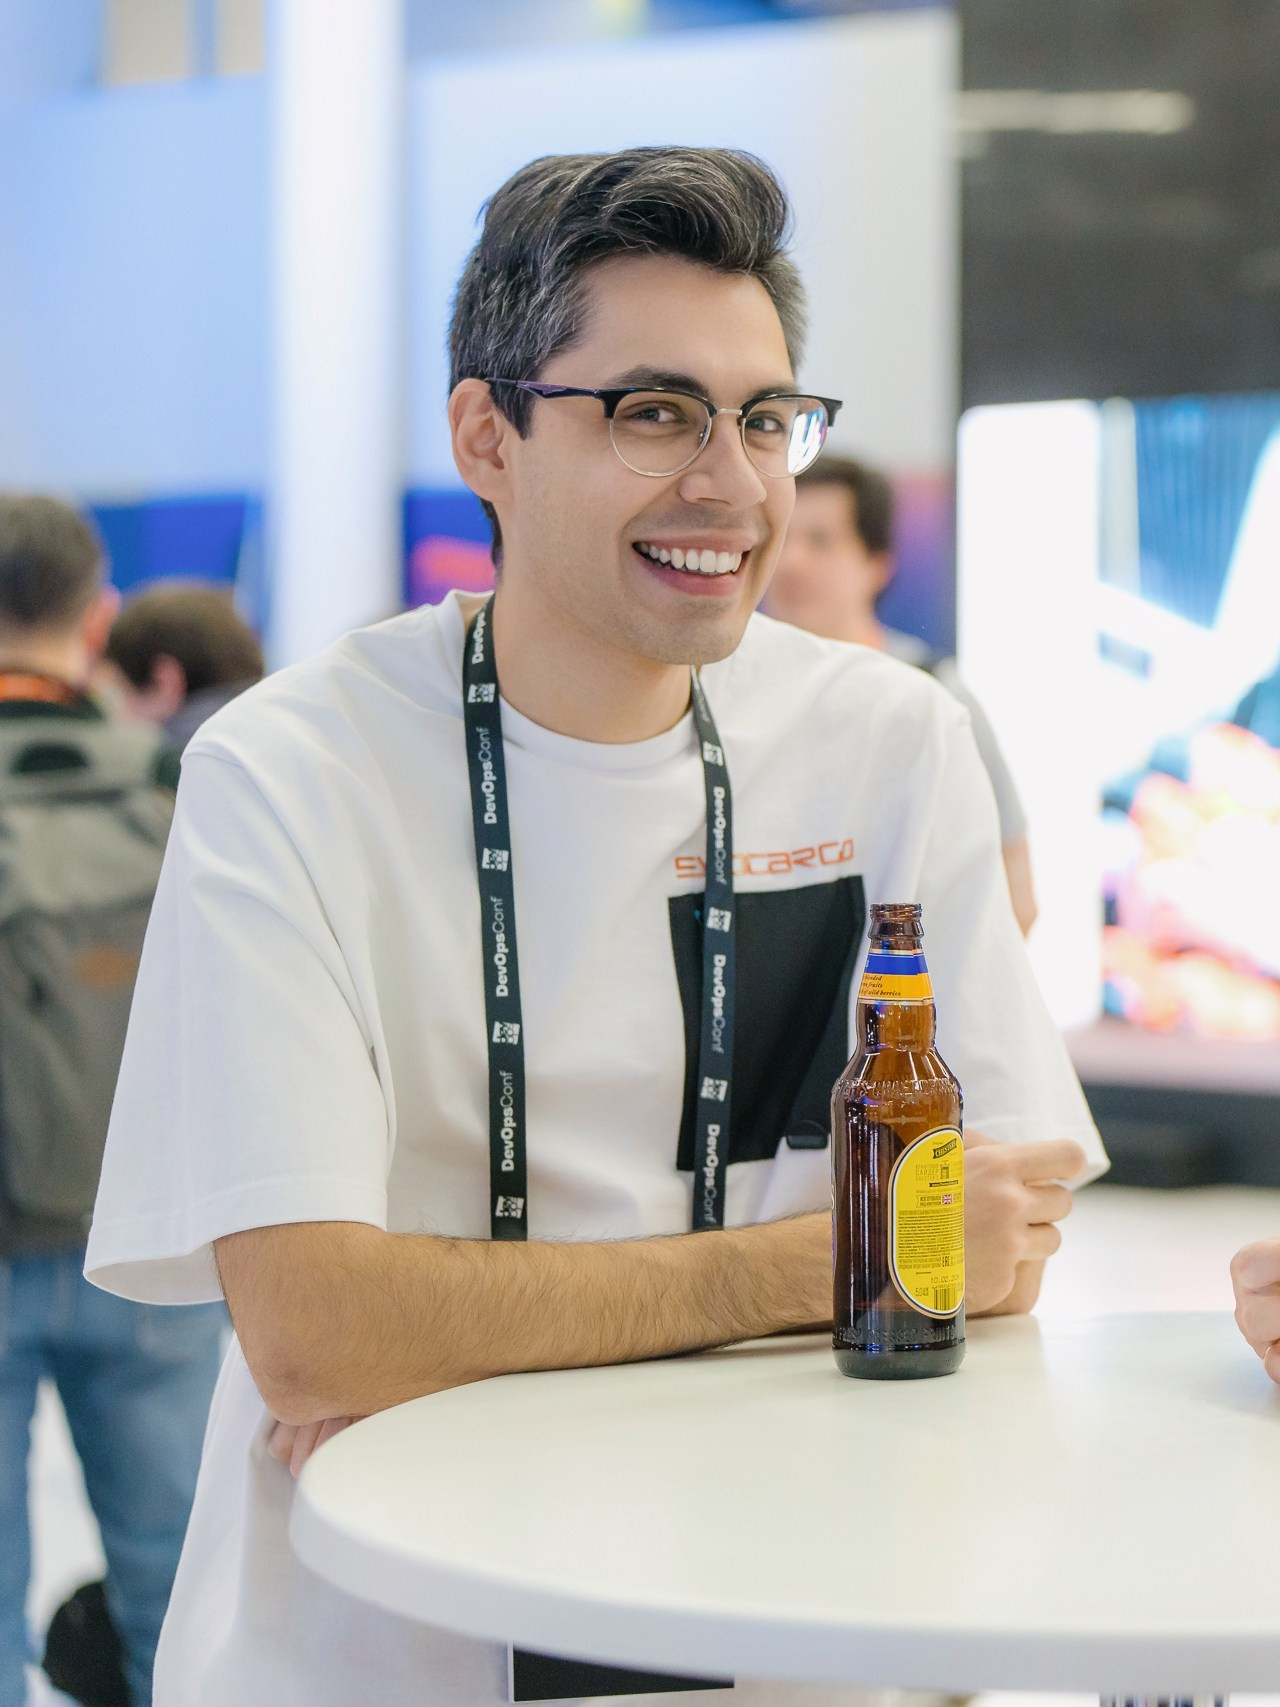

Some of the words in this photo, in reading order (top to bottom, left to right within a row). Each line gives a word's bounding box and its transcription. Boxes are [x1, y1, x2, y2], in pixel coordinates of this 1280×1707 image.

[471, 611, 487, 665] DevOps
[475, 726, 497, 825] DevOpsConf
[713, 785, 727, 886] DevOpsConf
[491, 896, 509, 998] DevOpsConf
[711, 954, 726, 1054] DevOpsConf
[499, 1070, 515, 1173] DevOpsConf
[703, 1124, 720, 1223] DevOpsConf
